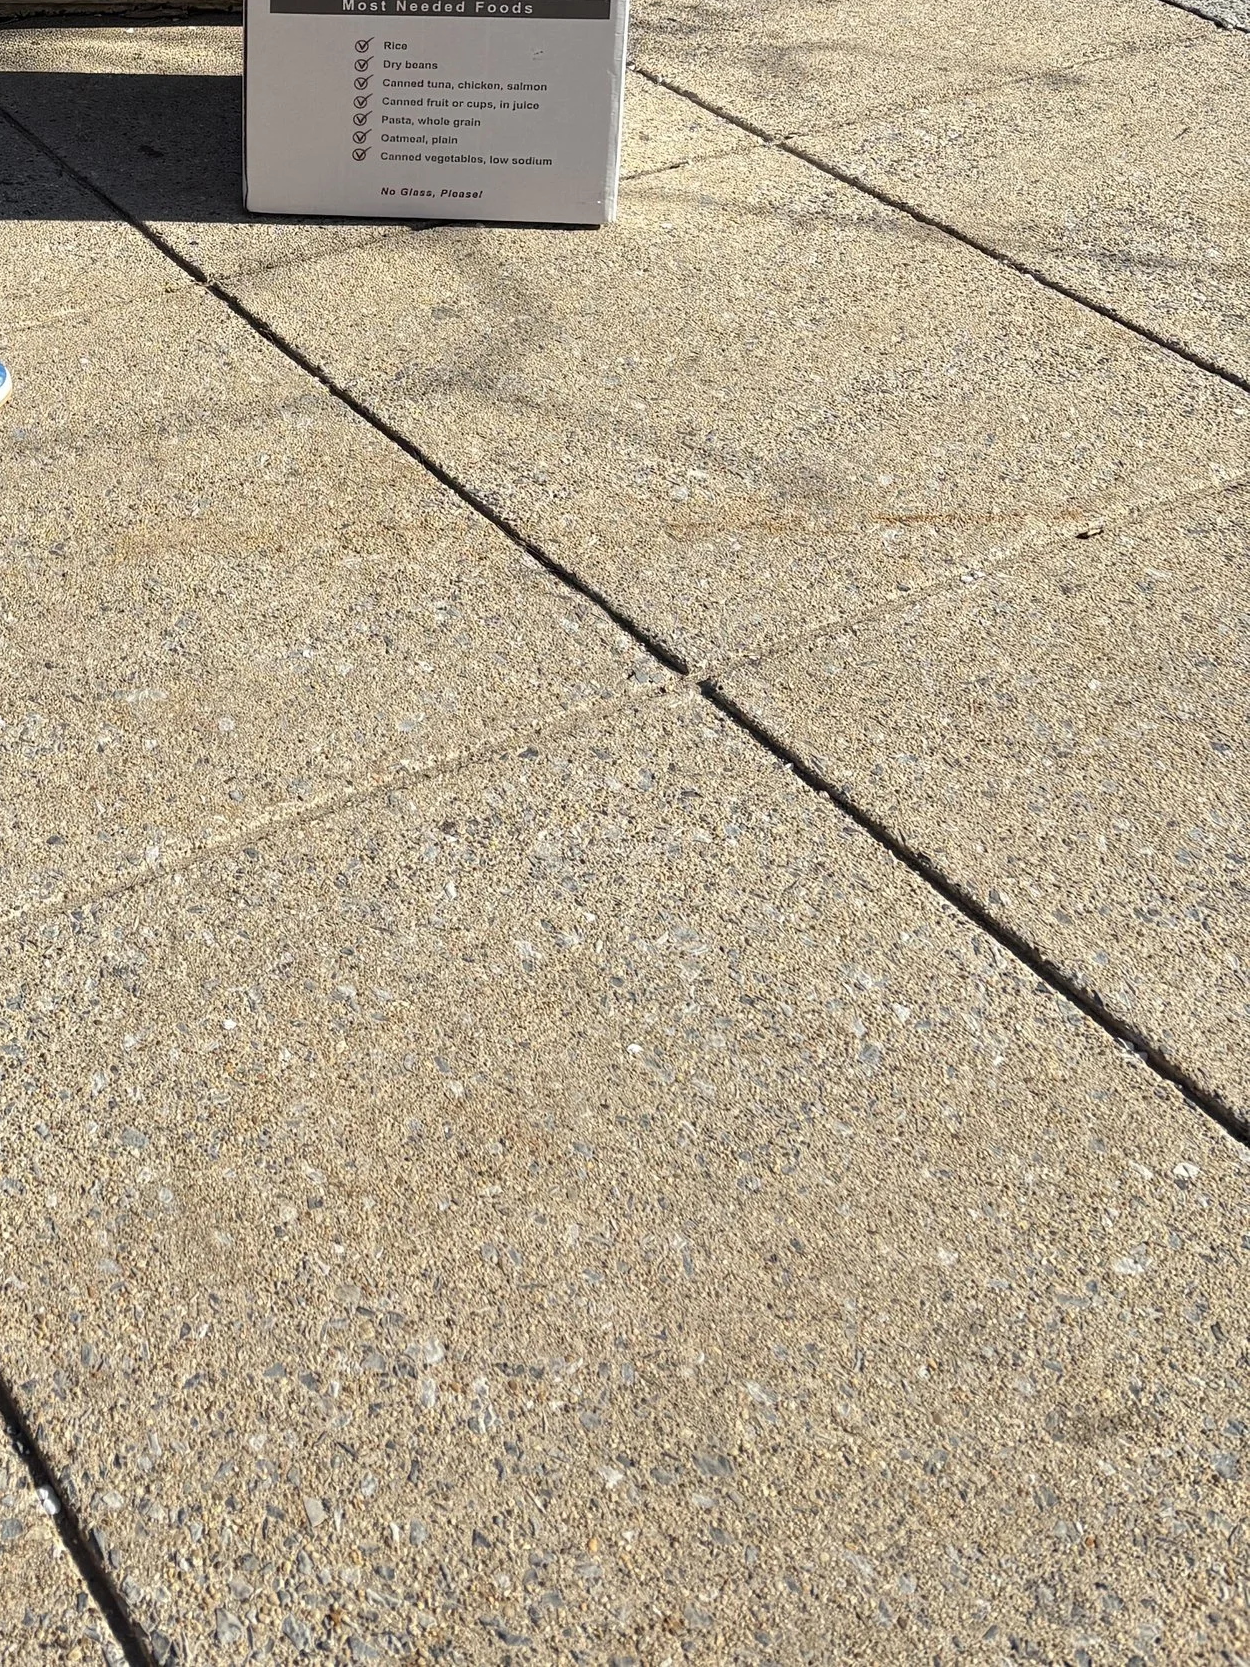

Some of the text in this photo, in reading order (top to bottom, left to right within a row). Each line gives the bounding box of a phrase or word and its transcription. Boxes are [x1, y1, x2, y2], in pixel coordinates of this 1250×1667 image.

[342, 0, 534, 14] Most Needed Foods
[383, 41, 408, 50] Rice
[383, 60, 438, 70] Dry beans
[382, 78, 548, 91] Canned tuna, chicken, salmon
[382, 97, 540, 111] Canned fruit or cups, in juice
[381, 115, 481, 128] Pasta, whole grain
[381, 134, 458, 145] Oatmeal, plain
[380, 152, 553, 165] Canned vegetables, low sodium
[380, 187, 483, 199] No Glass, Please!
